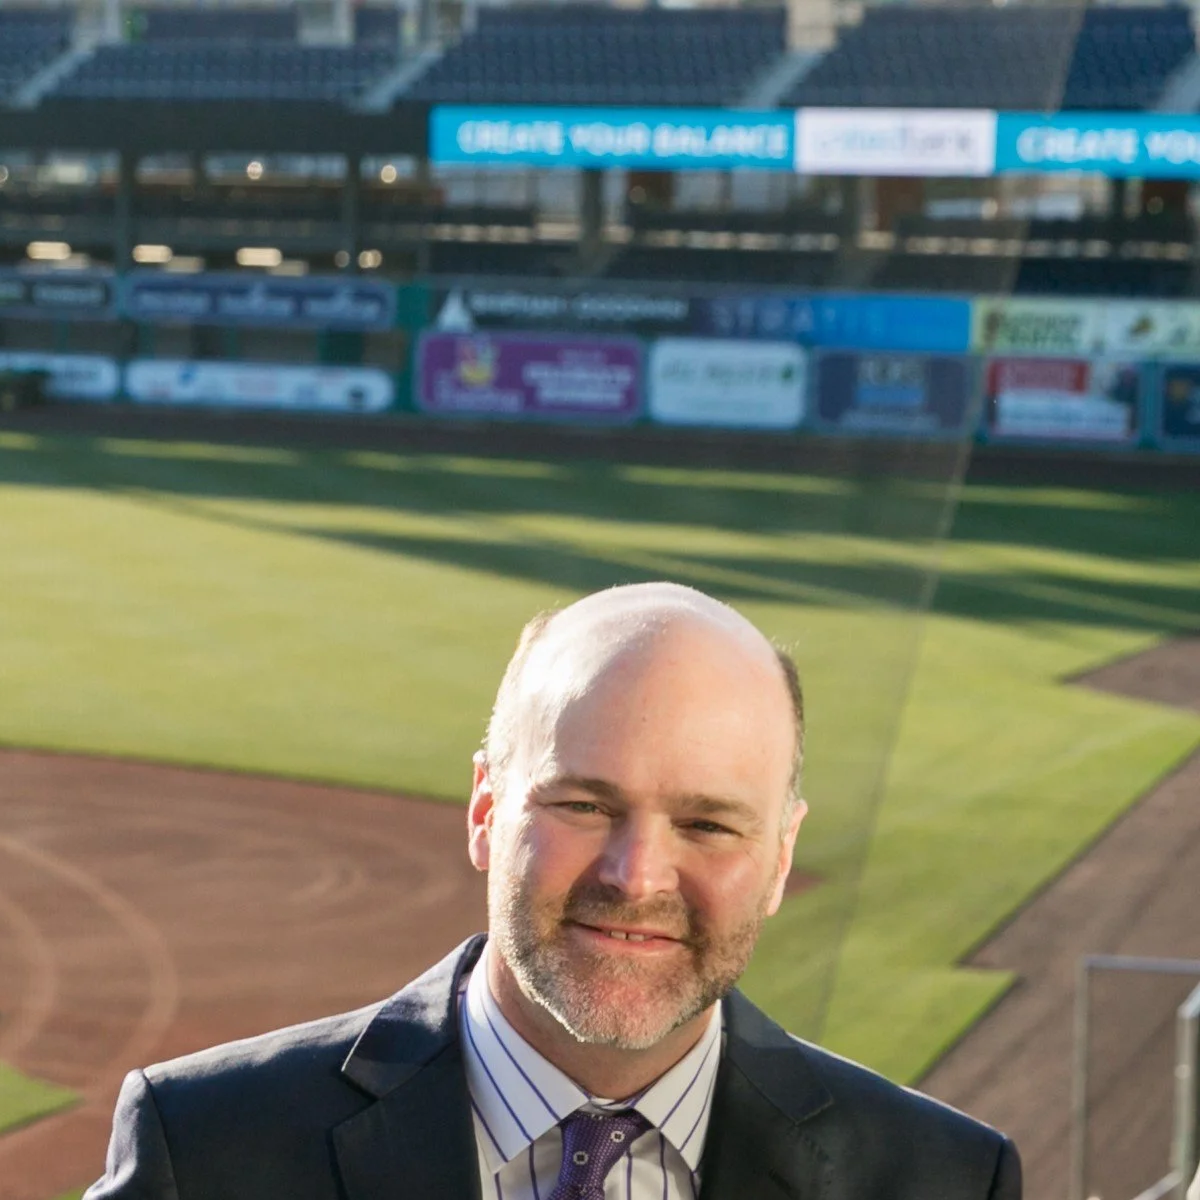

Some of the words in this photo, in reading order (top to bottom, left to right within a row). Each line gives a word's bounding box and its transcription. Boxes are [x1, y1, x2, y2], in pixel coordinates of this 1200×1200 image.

[456, 120, 563, 155] CREATE
[568, 121, 648, 156] YOUR
[653, 122, 787, 159] BALANCE
[1016, 127, 1136, 163] CREATE
